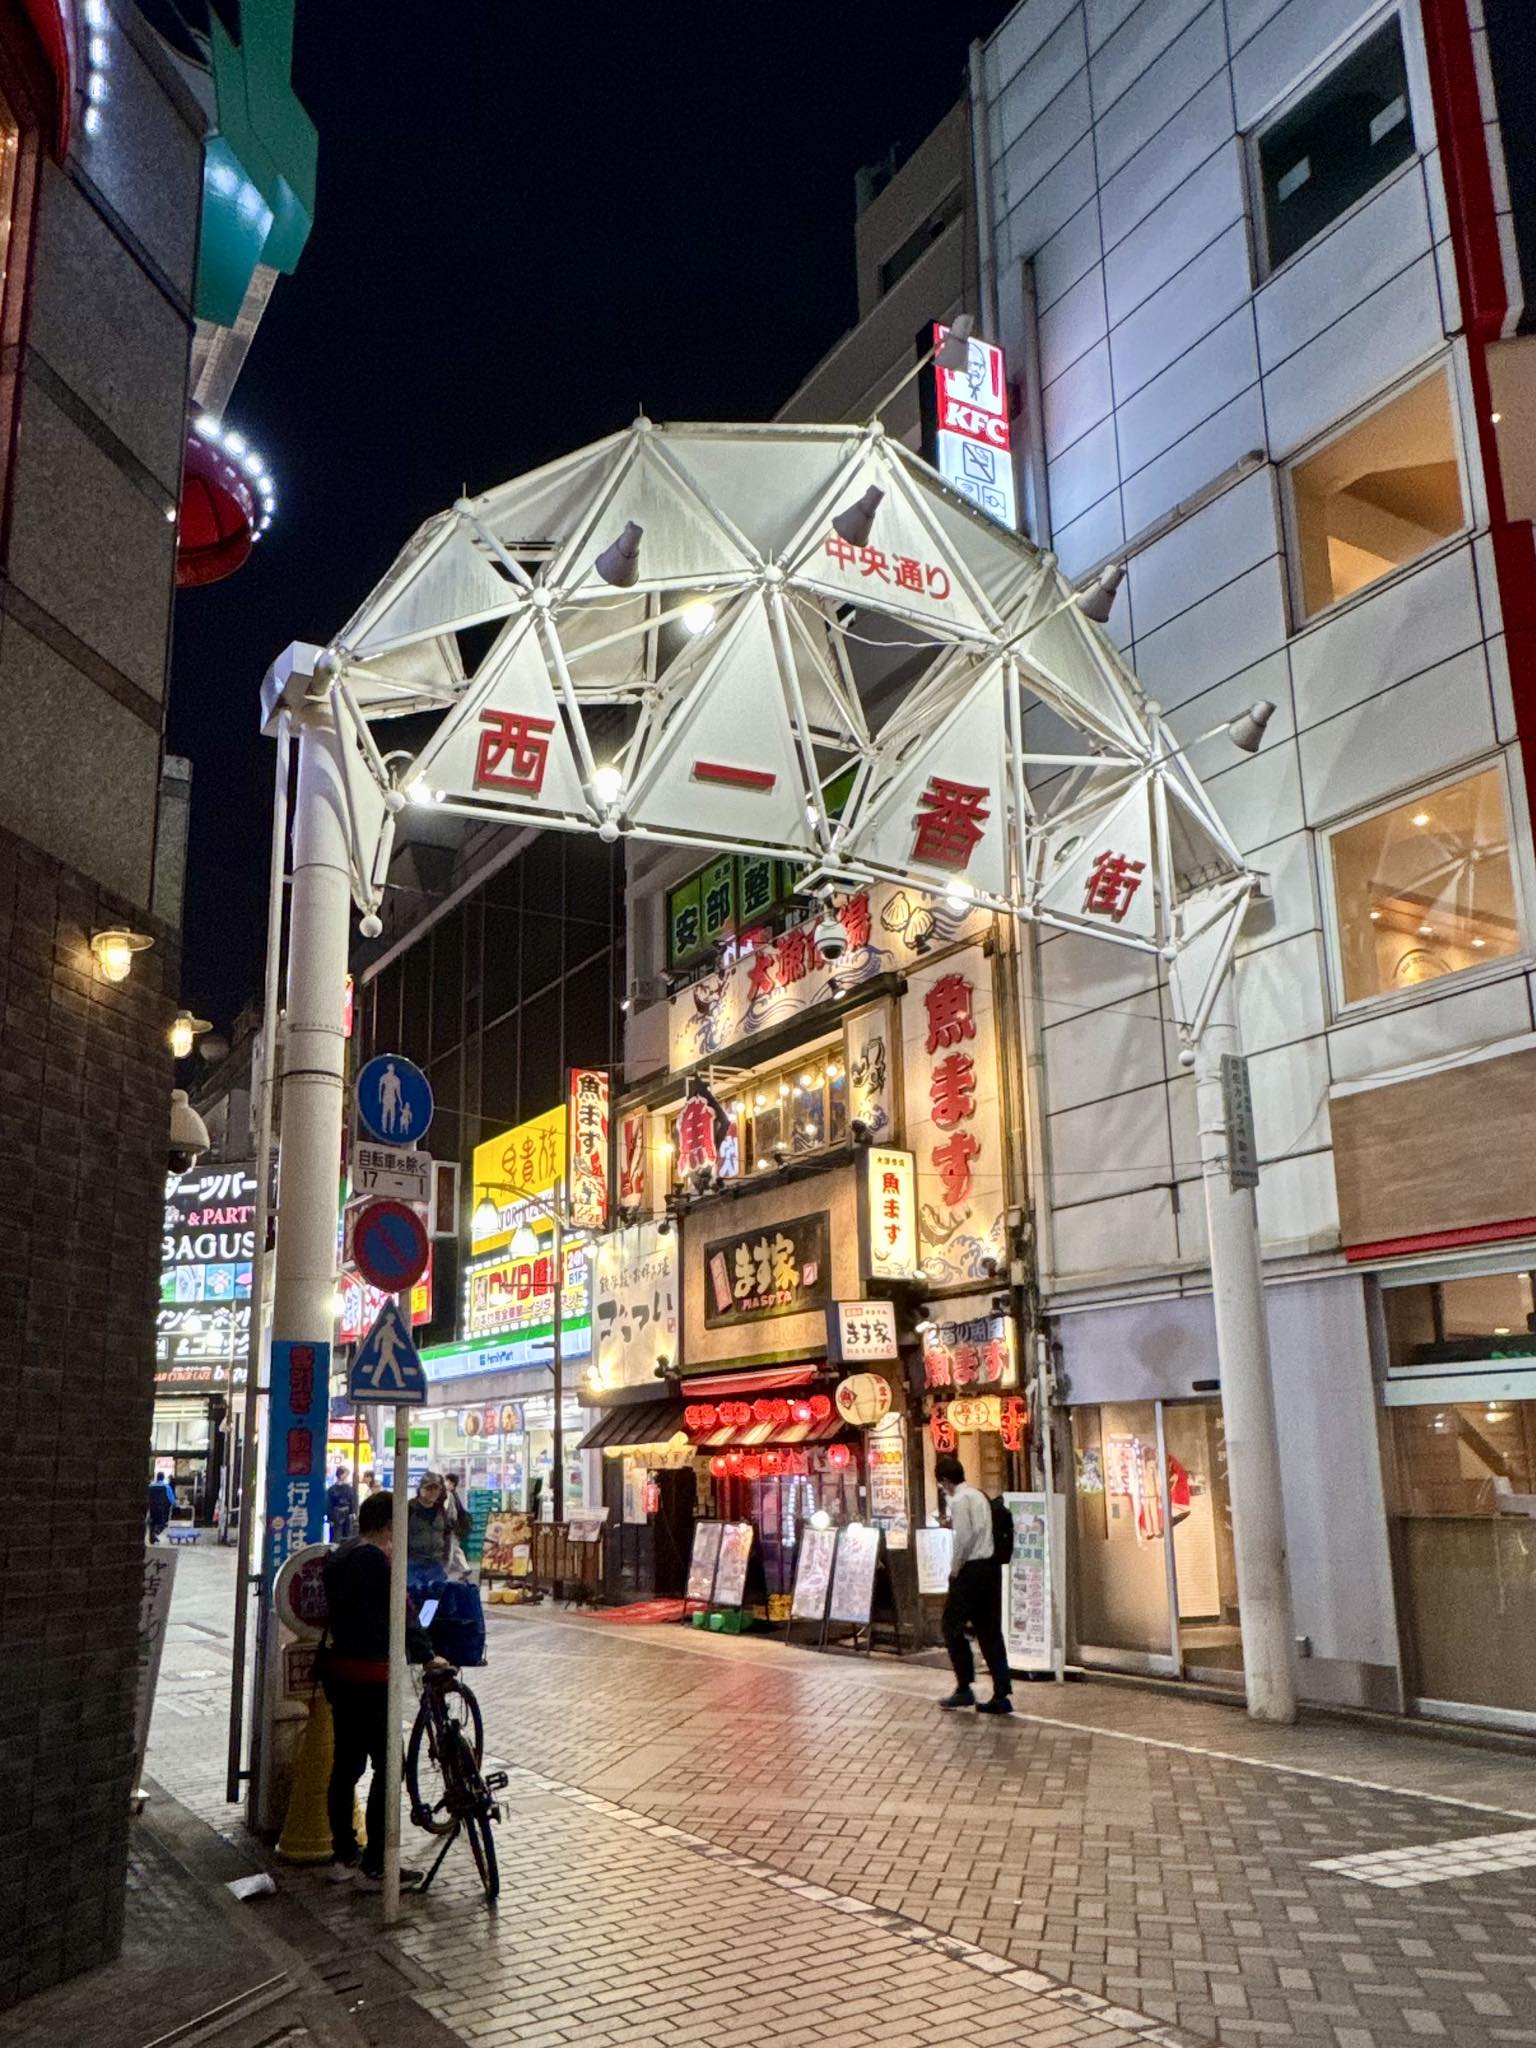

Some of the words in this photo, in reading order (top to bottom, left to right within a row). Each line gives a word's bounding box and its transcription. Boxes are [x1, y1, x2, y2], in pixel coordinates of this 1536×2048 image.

[946, 403, 1007, 444] KFC
[825, 535, 950, 600] 中央通り
[578, 1075, 601, 1154] 魚ます
[925, 973, 980, 1207] 魚ます
[359, 1150, 427, 1174] 自転車を除く
[202, 1206, 256, 1225] PART
[881, 1172, 901, 1245] 魚ます
[161, 1231, 255, 1260] BAGUS
[734, 1232, 800, 1299] ます家
[846, 1319, 892, 1345] ます家
[924, 1338, 1009, 1390] 魚ます
